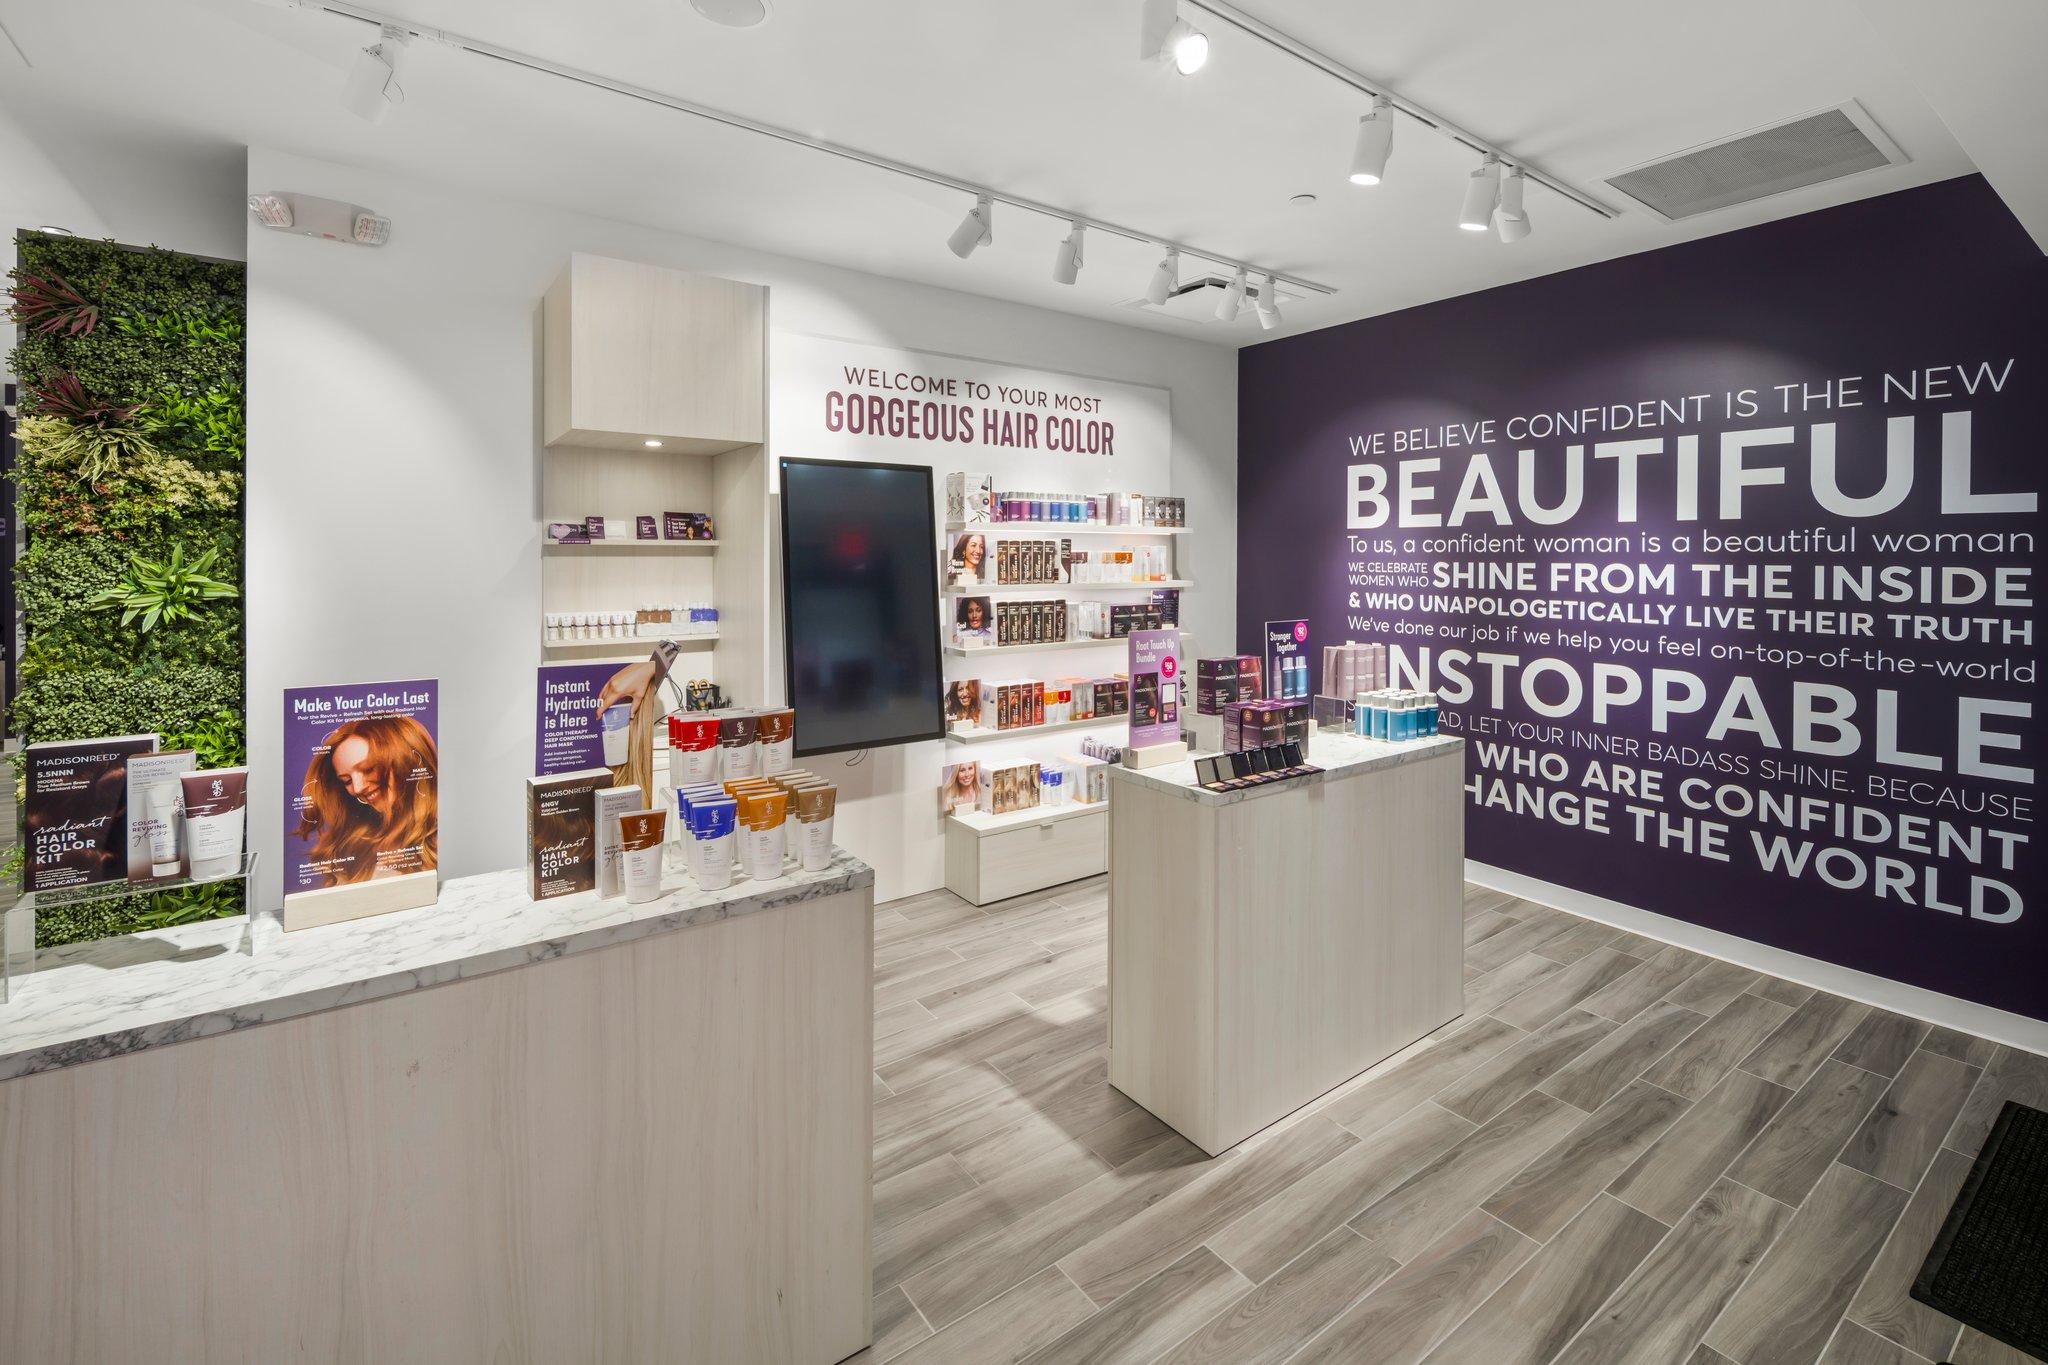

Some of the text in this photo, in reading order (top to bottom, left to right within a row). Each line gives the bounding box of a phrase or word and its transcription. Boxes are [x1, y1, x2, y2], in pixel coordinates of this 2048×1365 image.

[844, 366, 1101, 414] WELCOME TO YOUR MOST
[1349, 359, 2014, 456] WE BELIEVE CONFIDENT IS THE NEW
[825, 391, 1114, 456] GORGEOUS HAIR COLOR
[1347, 410, 2038, 529] BEAUTIFUL
[1347, 527, 2033, 556] To us, a confident woman is a beautiful woman
[1348, 562, 1428, 573] WE CELEBRATE
[1349, 575, 1429, 587] WOMEN WHO
[1433, 562, 2033, 607] SHINE FROM THE INSIDE
[1349, 592, 2032, 645] & WHO UNAPOLOGETICALLY LIVE THEIR TRUTH
[1270, 632, 1291, 642] Stronger
[1136, 639, 1174, 651] Root Touch Up
[1276, 642, 1297, 654] Together
[1348, 616, 2035, 683] We've done our job if we help you feel on-top-of-the-world
[1136, 652, 1156, 663] Bundle
[545, 680, 590, 694] Instant
[295, 692, 429, 713] Make Your Color Last
[545, 696, 603, 715] Hydration
[545, 713, 587, 729] is Here
[1389, 644, 2034, 784] NSTOPPABLE
[37, 754, 117, 766] MADISONREED
[38, 769, 73, 778] 5.5NNN
[1470, 715, 2033, 822] LET YOUR INNER BADASS SHINE. BECAUSE
[541, 786, 591, 799] MADISONREED
[1476, 741, 2029, 870] WHO ARE CONFIDENT
[33, 816, 111, 835] radiant
[132, 824, 167, 832] REVIVING
[37, 832, 76, 844] HAIR
[539, 837, 589, 854] radiant
[36, 839, 96, 854] COLOR
[1464, 774, 2024, 924] HANGE THE WORLD
[37, 853, 63, 864] KIT
[542, 851, 567, 861] HAIR
[542, 856, 579, 869] COLOR
[542, 868, 559, 877] KIT
[40, 877, 88, 888] APPLICATION
